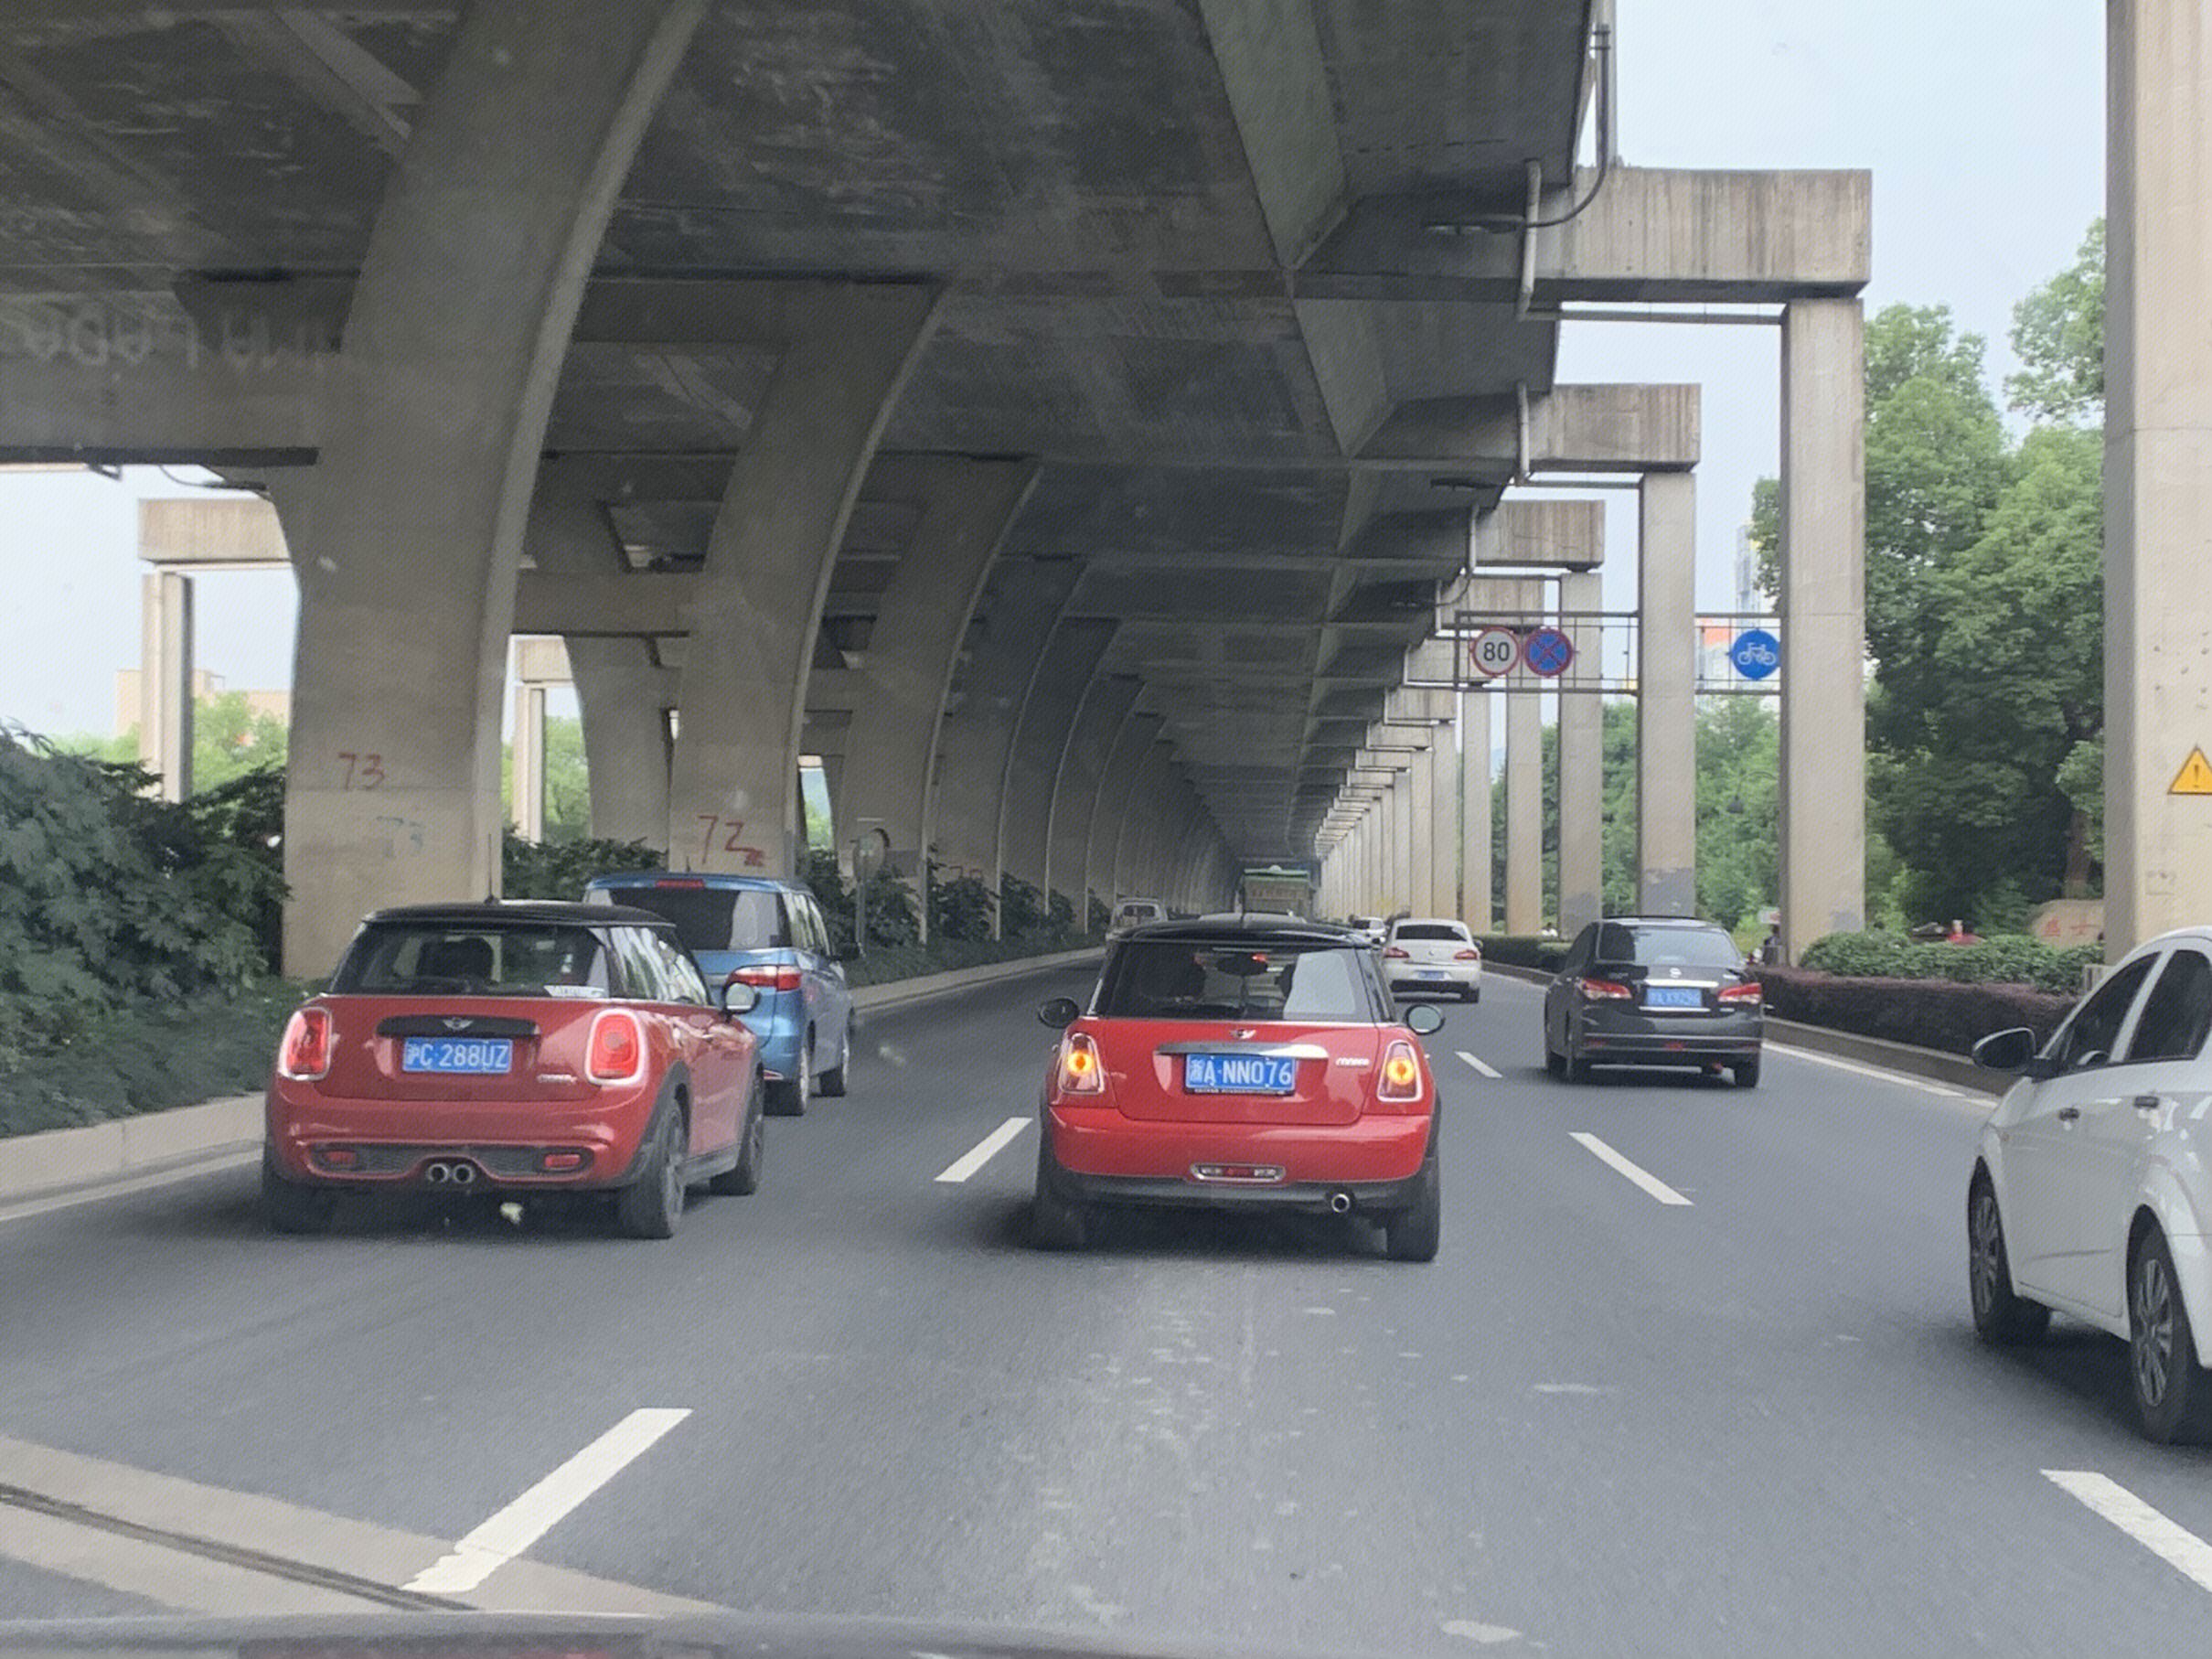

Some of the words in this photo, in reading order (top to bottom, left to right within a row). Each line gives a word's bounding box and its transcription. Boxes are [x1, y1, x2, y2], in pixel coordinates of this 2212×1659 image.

[1483, 641, 1510, 662] 80
[337, 752, 385, 791] 73
[698, 814, 764, 867] 72
